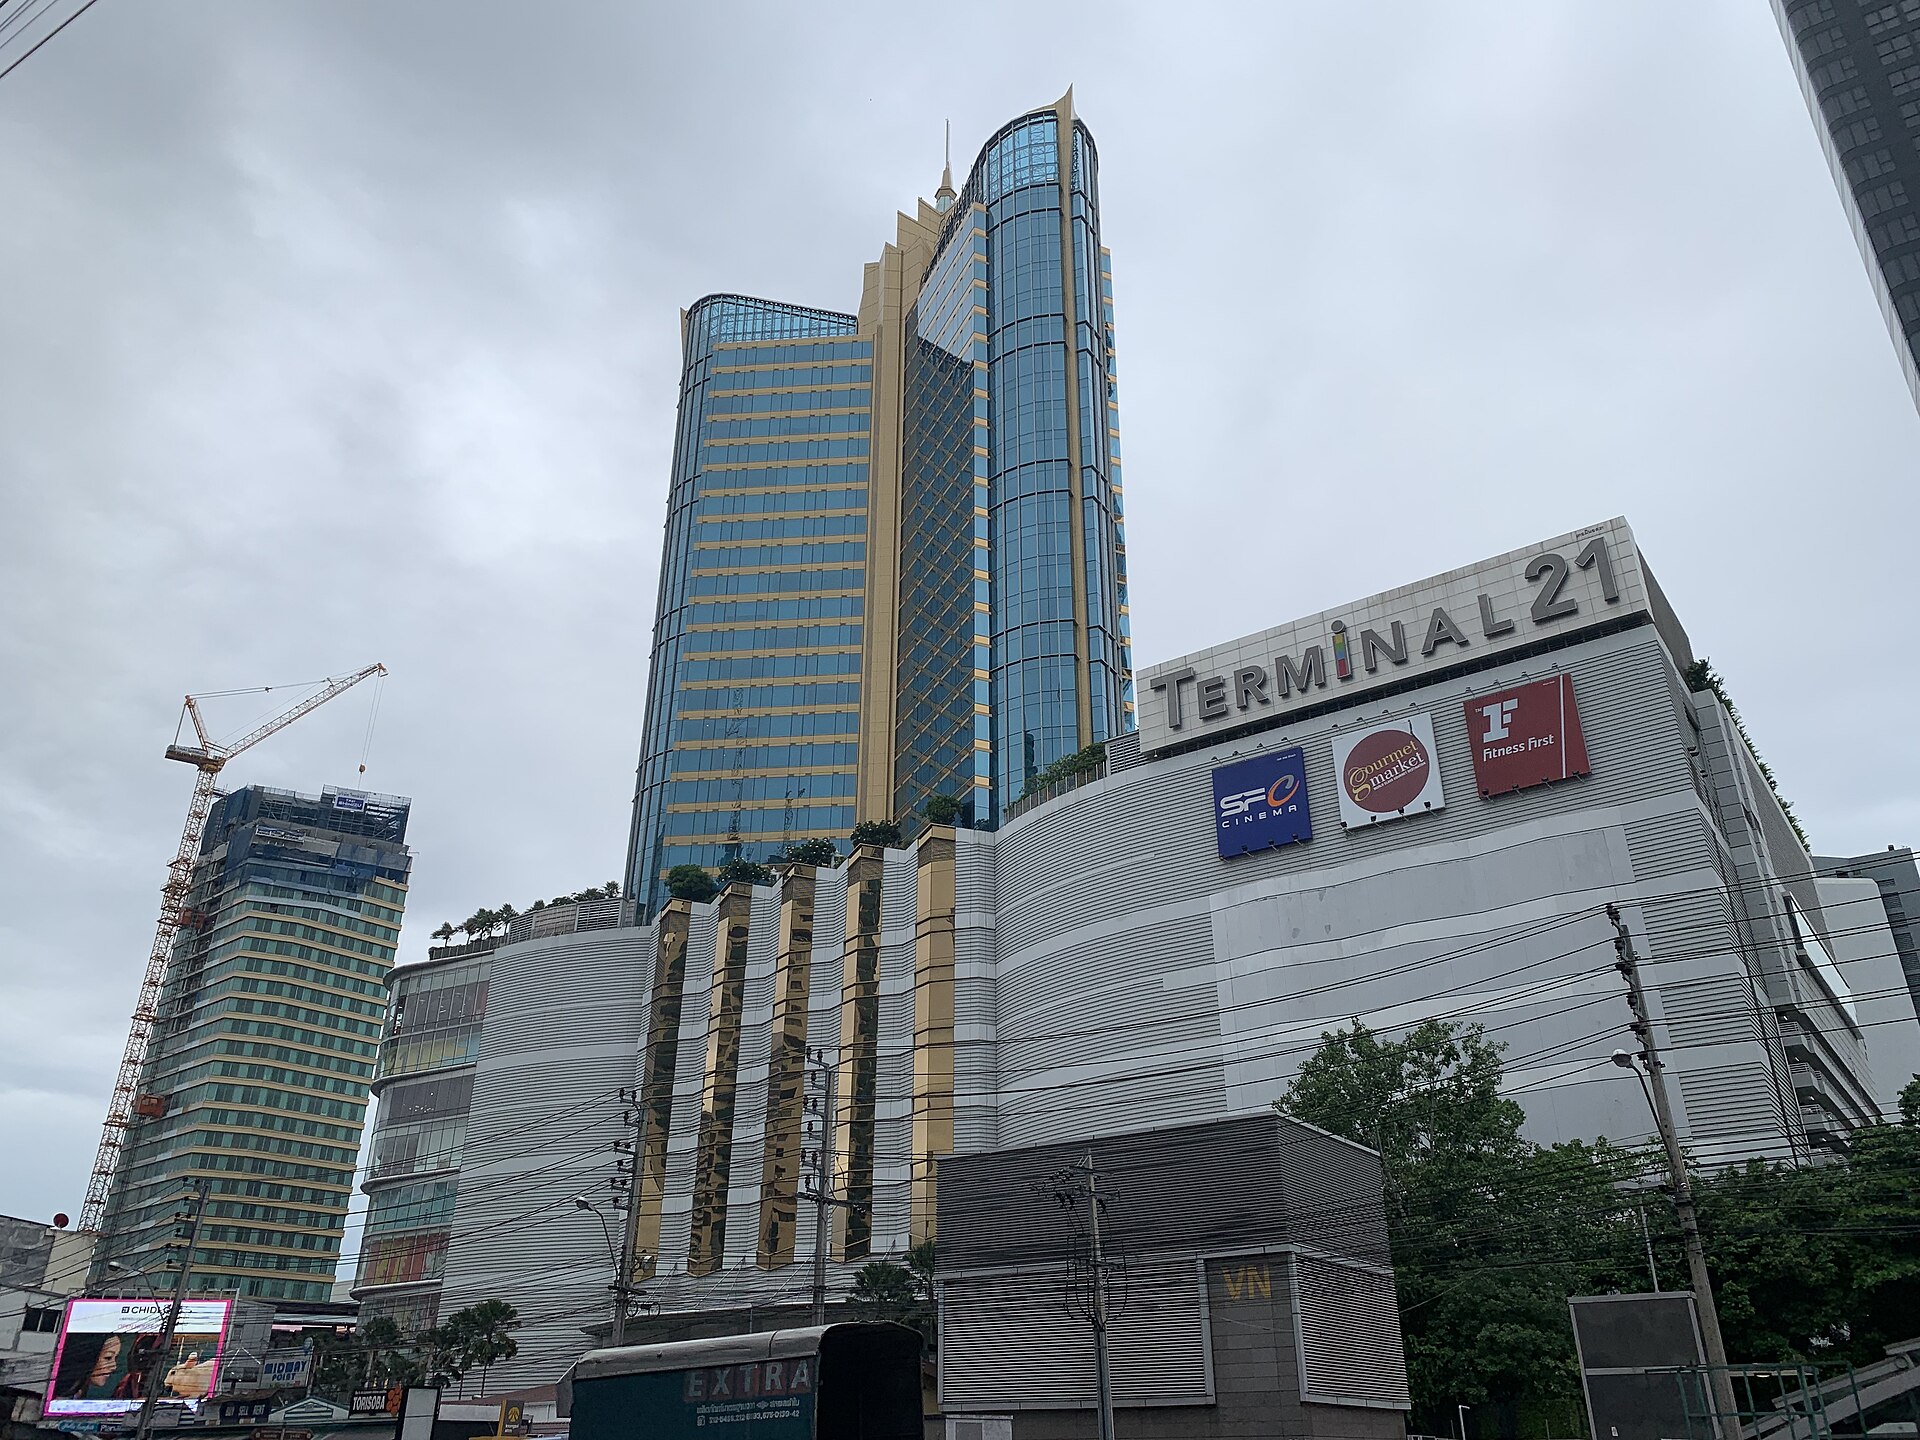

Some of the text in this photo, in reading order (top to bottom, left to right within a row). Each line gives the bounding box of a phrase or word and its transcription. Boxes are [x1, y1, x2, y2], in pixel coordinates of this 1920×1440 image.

[1524, 536, 1619, 623] 21
[1483, 733, 1555, 762] Fitness First
[1369, 751, 1424, 788] market
[1221, 804, 1298, 828] CINEMA
[264, 1360, 307, 1375] MIDWAY
[272, 1372, 296, 1381] POINT
[688, 1360, 812, 1397] EXTRA
[352, 1395, 386, 1411] TORISOBA
